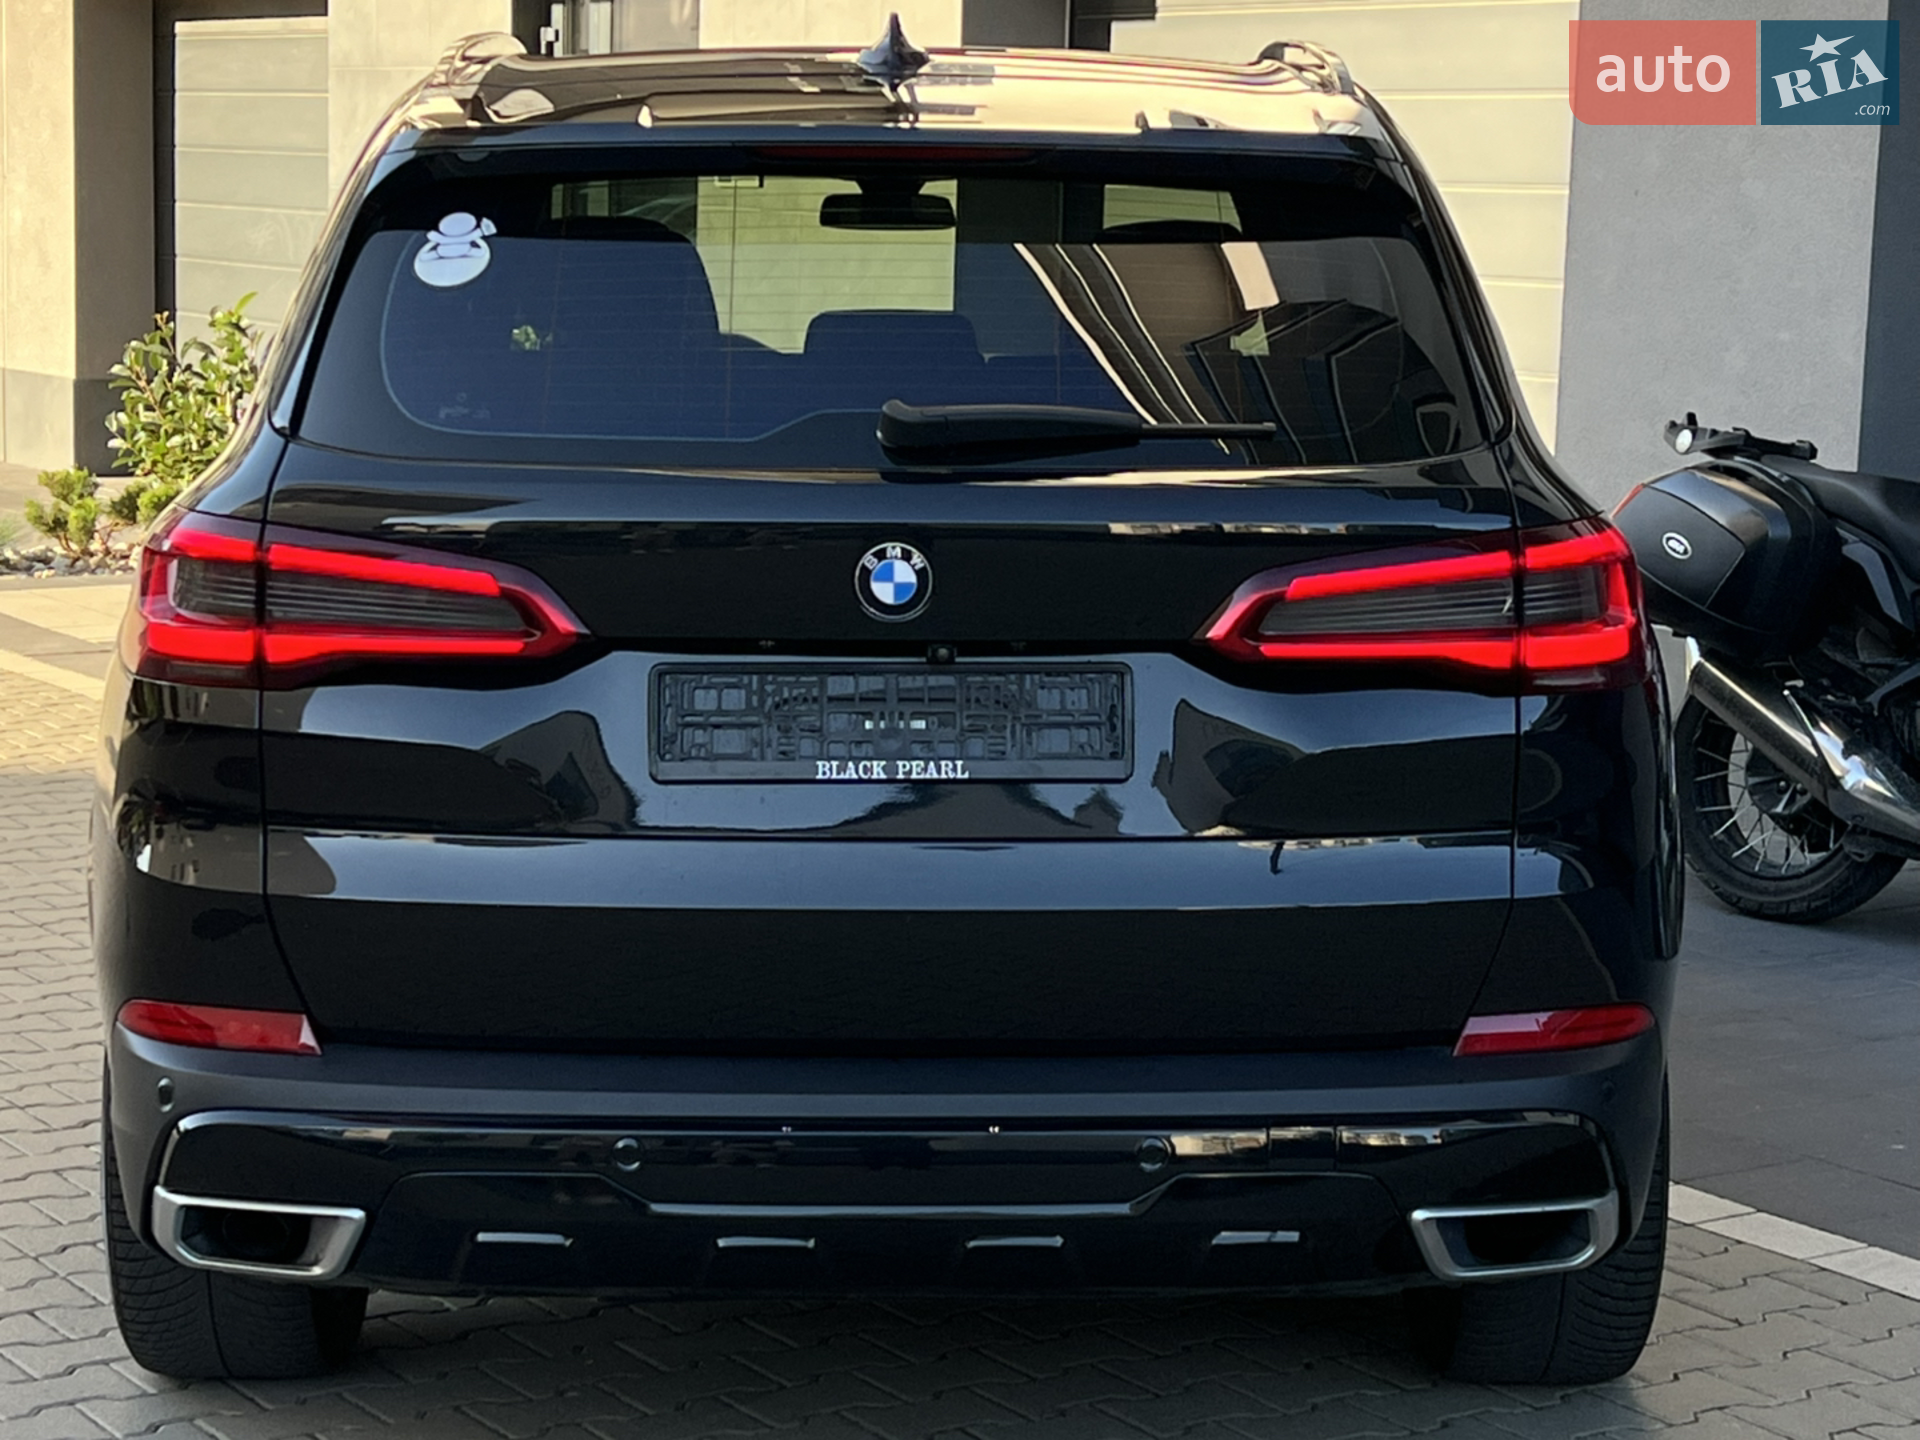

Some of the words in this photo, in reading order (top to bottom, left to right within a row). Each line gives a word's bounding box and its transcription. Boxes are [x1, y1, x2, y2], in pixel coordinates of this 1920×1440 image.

[863, 546, 925, 571] BMW
[815, 759, 887, 779] BLACK
[896, 759, 970, 779] PEARL
